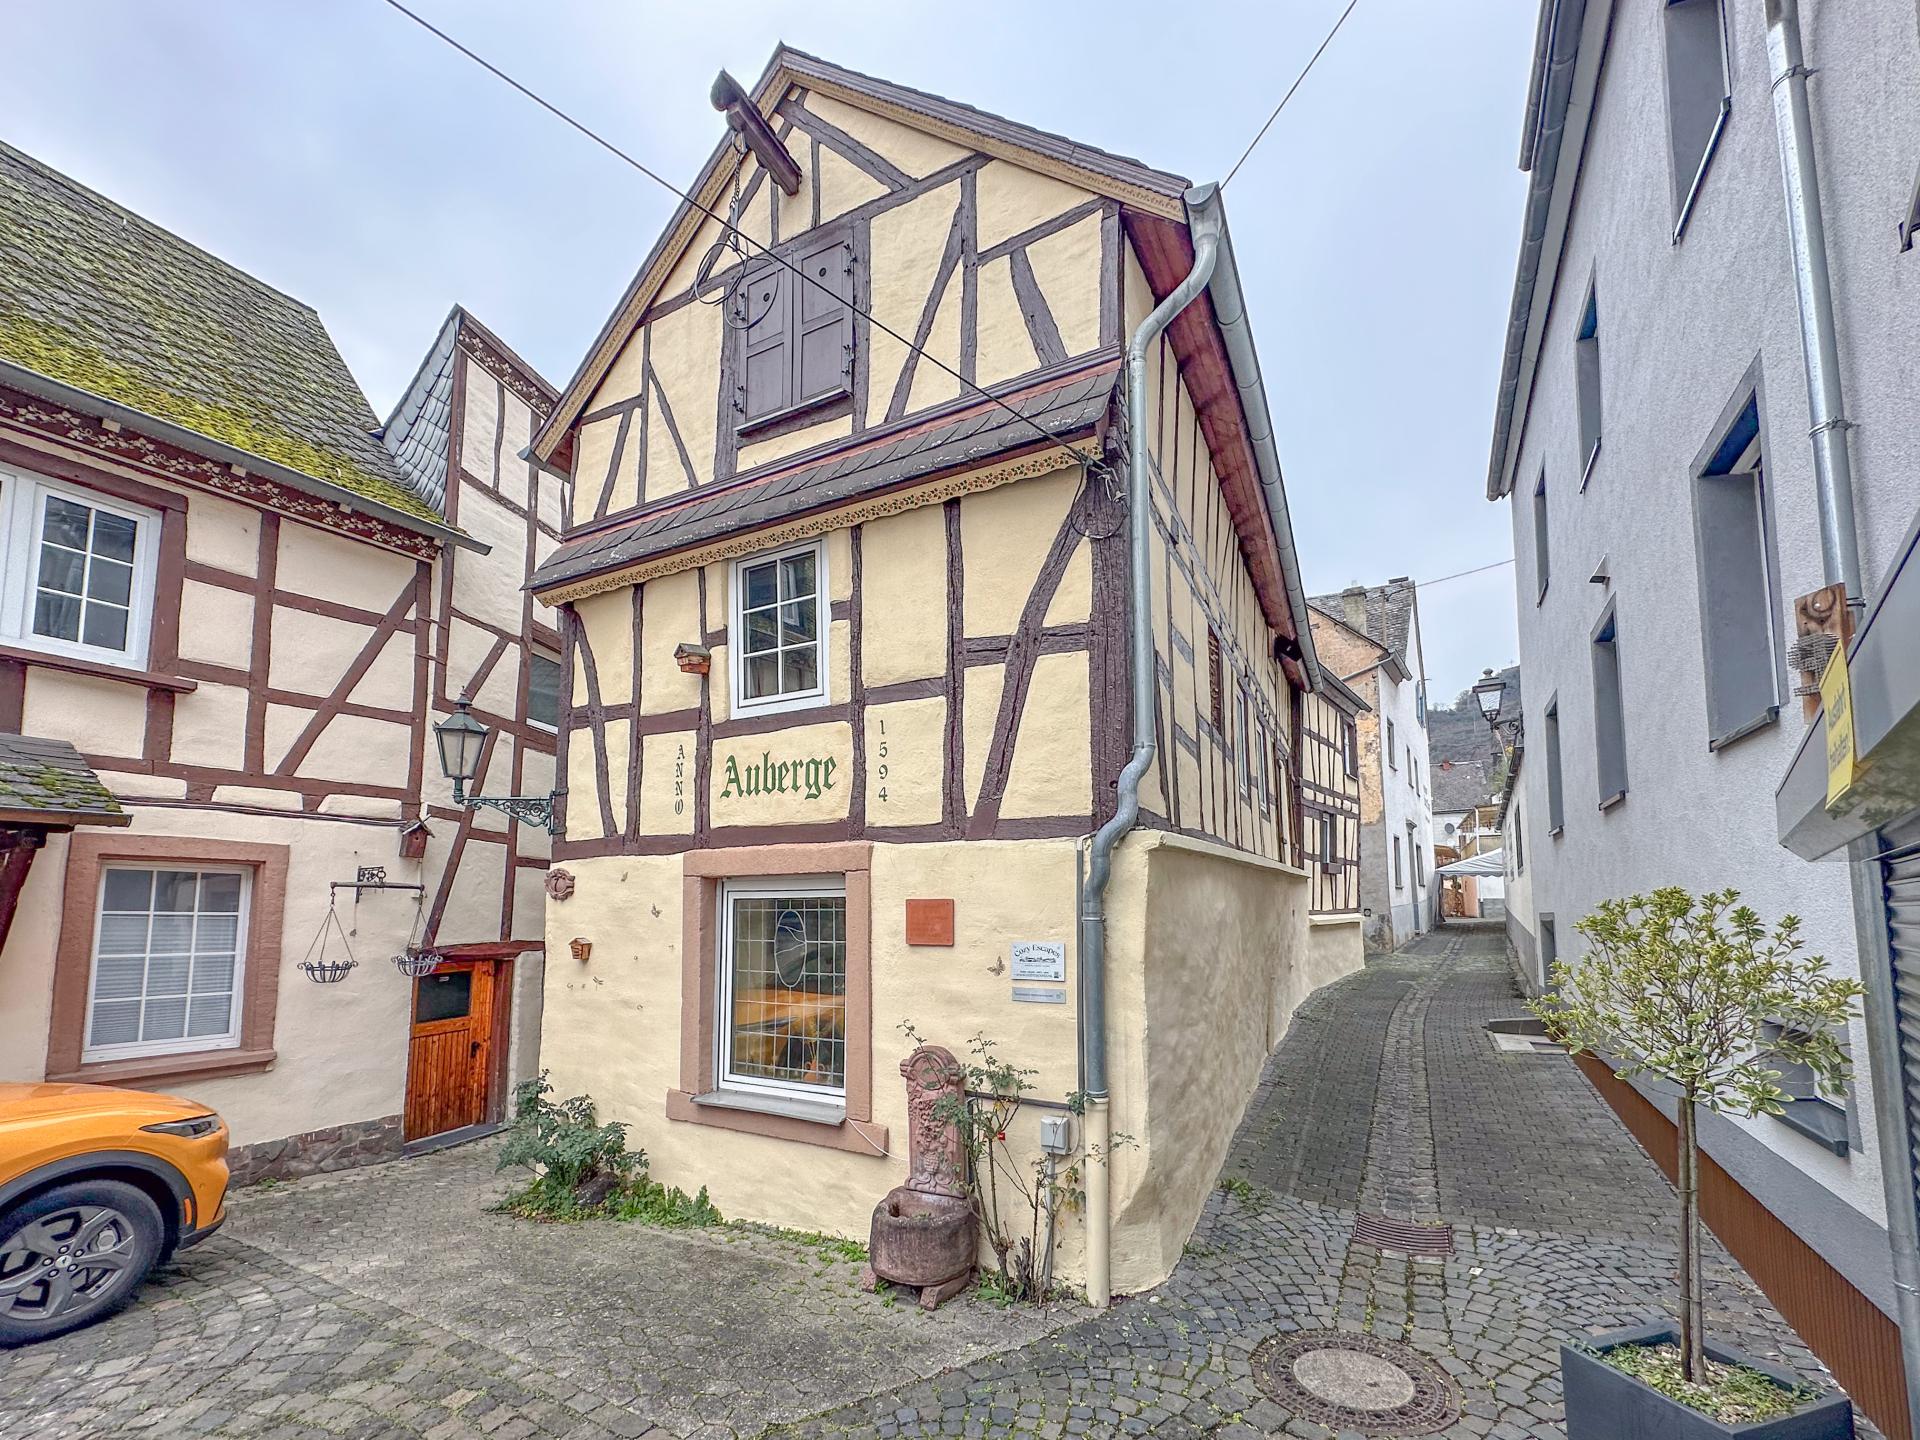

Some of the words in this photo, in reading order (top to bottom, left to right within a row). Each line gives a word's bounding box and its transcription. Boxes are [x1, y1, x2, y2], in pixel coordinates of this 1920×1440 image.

[674, 744, 685, 816] ANNO
[720, 750, 837, 800] Auberge
[878, 719, 889, 802] 1594
